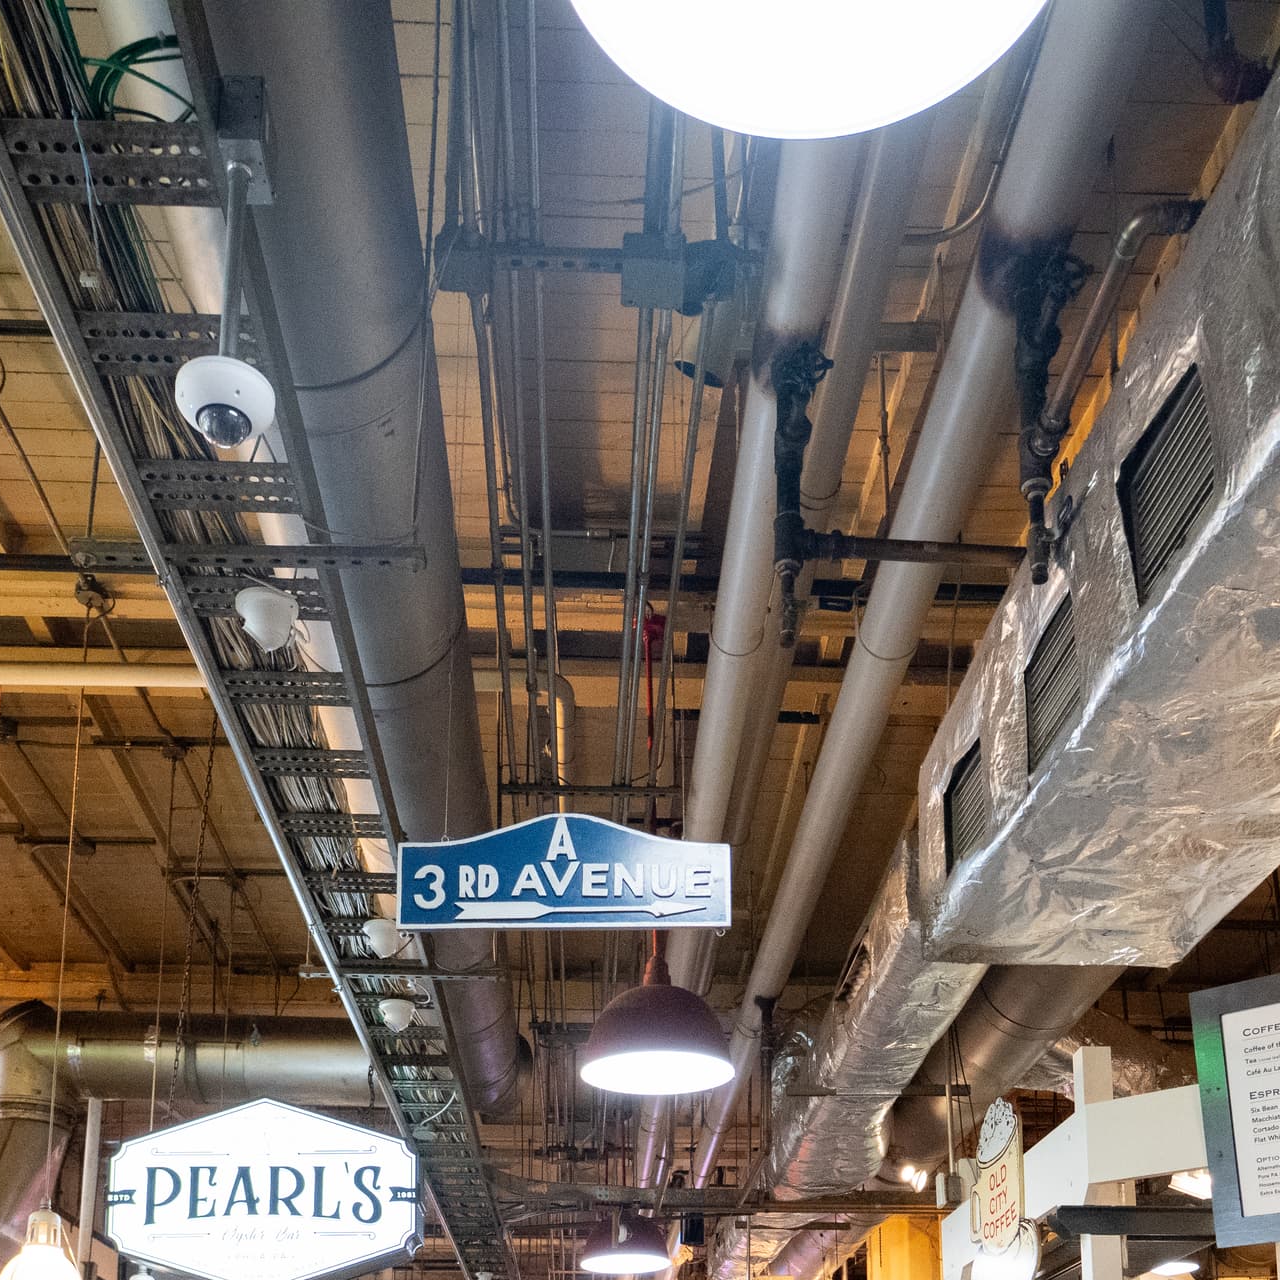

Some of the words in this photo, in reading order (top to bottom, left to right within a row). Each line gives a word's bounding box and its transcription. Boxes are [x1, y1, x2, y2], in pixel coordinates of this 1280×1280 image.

[546, 816, 578, 861] A
[413, 865, 446, 910] 3
[458, 864, 499, 899] RD
[511, 861, 712, 898] AVENUE
[1244, 1044, 1265, 1054] Coffee
[1253, 1124, 1279, 1134] Cortado
[143, 1161, 382, 1226] PEARL'S
[989, 1164, 1007, 1191] OLD
[989, 1187, 1008, 1215] CITY
[983, 1202, 1017, 1240] COFFEE
